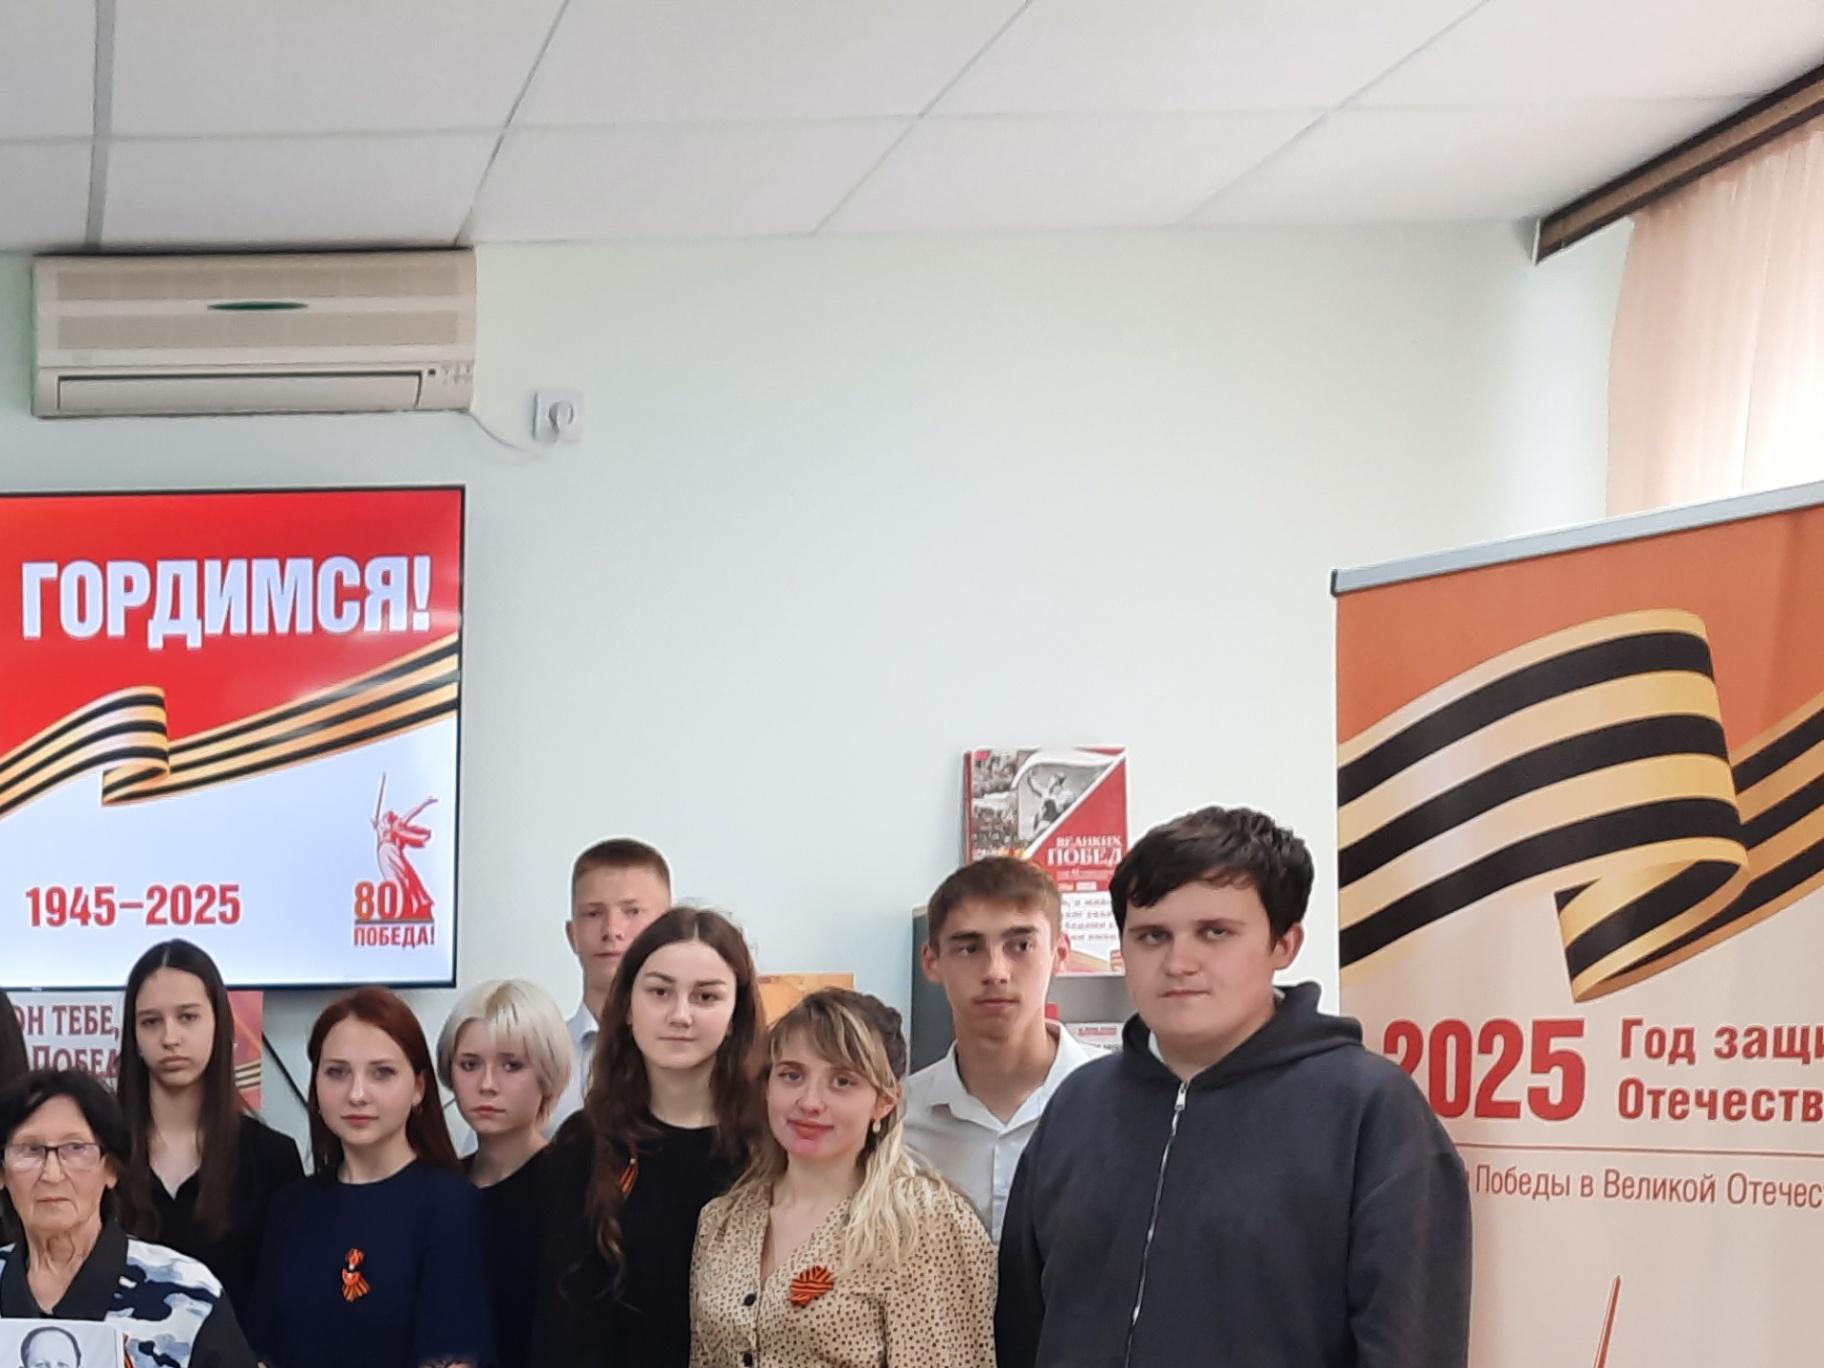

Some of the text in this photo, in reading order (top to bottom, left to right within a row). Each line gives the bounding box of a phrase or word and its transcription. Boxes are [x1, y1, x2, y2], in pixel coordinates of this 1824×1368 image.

[22, 555, 432, 649] ГОРДИМСЯ!
[354, 880, 398, 920] 80
[354, 926, 435, 950] ПОБЕДА!
[52, 1005, 120, 1042] ТЕБЕ,
[1621, 1018, 1696, 1066] Год
[1382, 1018, 1587, 1121] 2025
[1476, 1164, 1824, 1208] Победы в Великой Отечес
